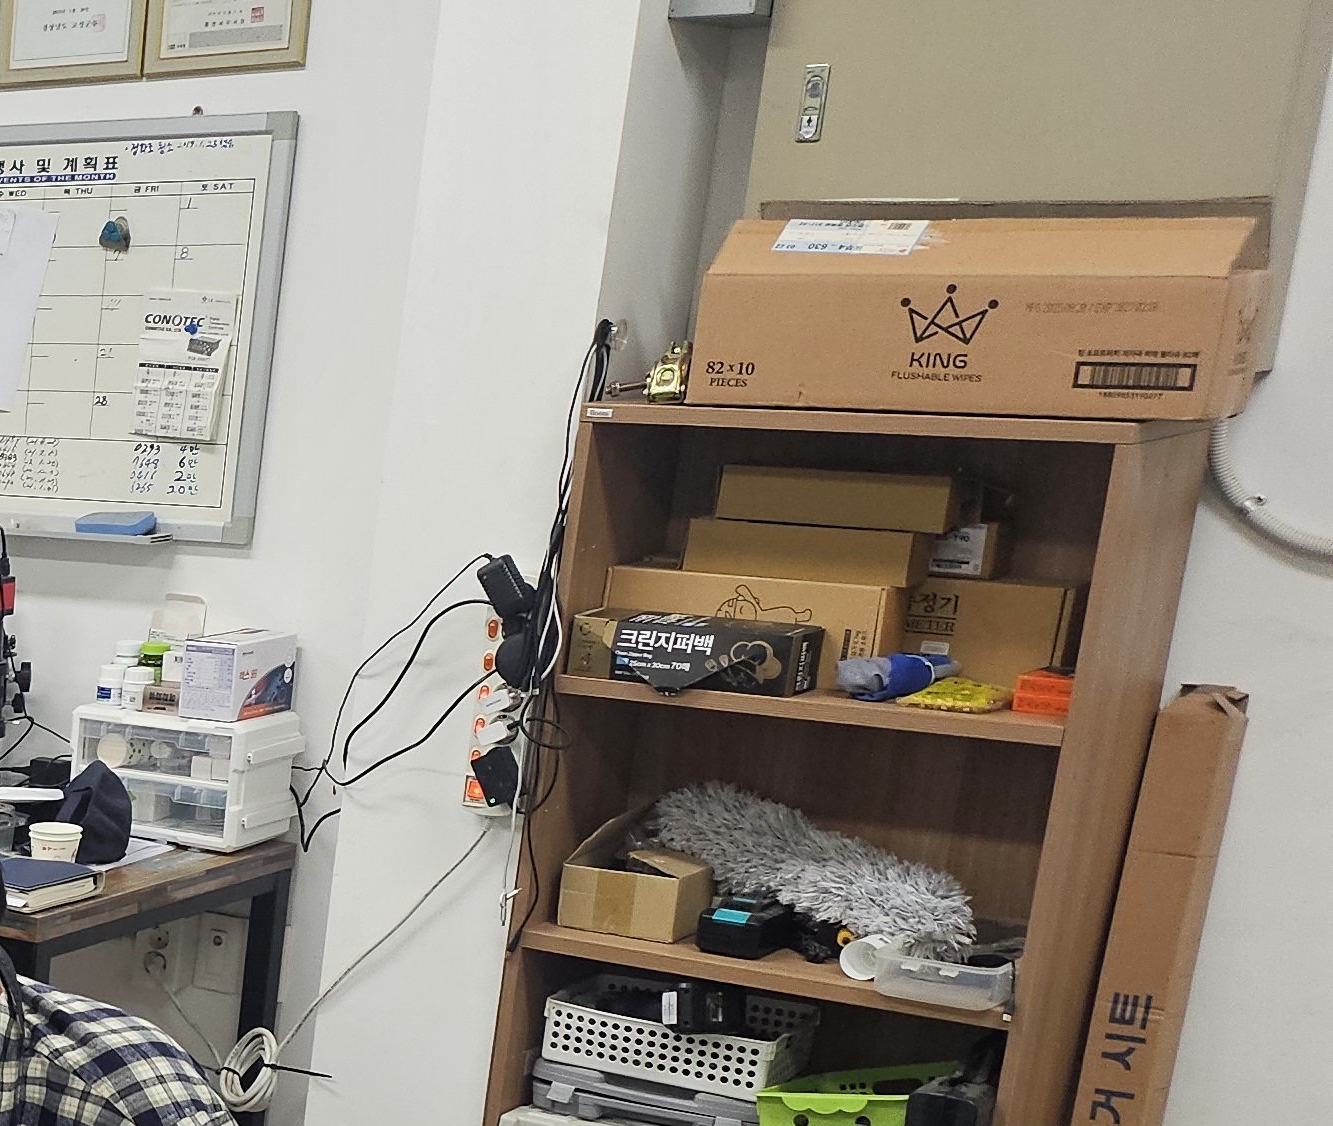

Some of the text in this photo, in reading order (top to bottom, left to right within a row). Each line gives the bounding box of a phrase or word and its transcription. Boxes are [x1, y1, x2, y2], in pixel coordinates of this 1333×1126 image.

[36, 158, 51, 174] 및
[63, 155, 119, 173] 계획표
[33, 175, 47, 183] OF
[50, 174, 72, 182] THE
[74, 173, 114, 181] MONTH
[8, 189, 27, 197] WED
[75, 187, 93, 195] THU
[145, 184, 160, 193] FRI
[213, 182, 234, 191] SAT
[180, 246, 189, 259] 8
[144, 313, 205, 328] CONOTEC
[909, 352, 969, 370] KING
[705, 361, 724, 375] 82
[737, 361, 755, 376] 10
[709, 377, 748, 388] PIECES
[890, 370, 983, 383] FLUSHABLE WIPES
[94, 395, 109, 406] 28
[616, 629, 715, 656] 크린지퍼백
[1100, 992, 1153, 1072] 시트
